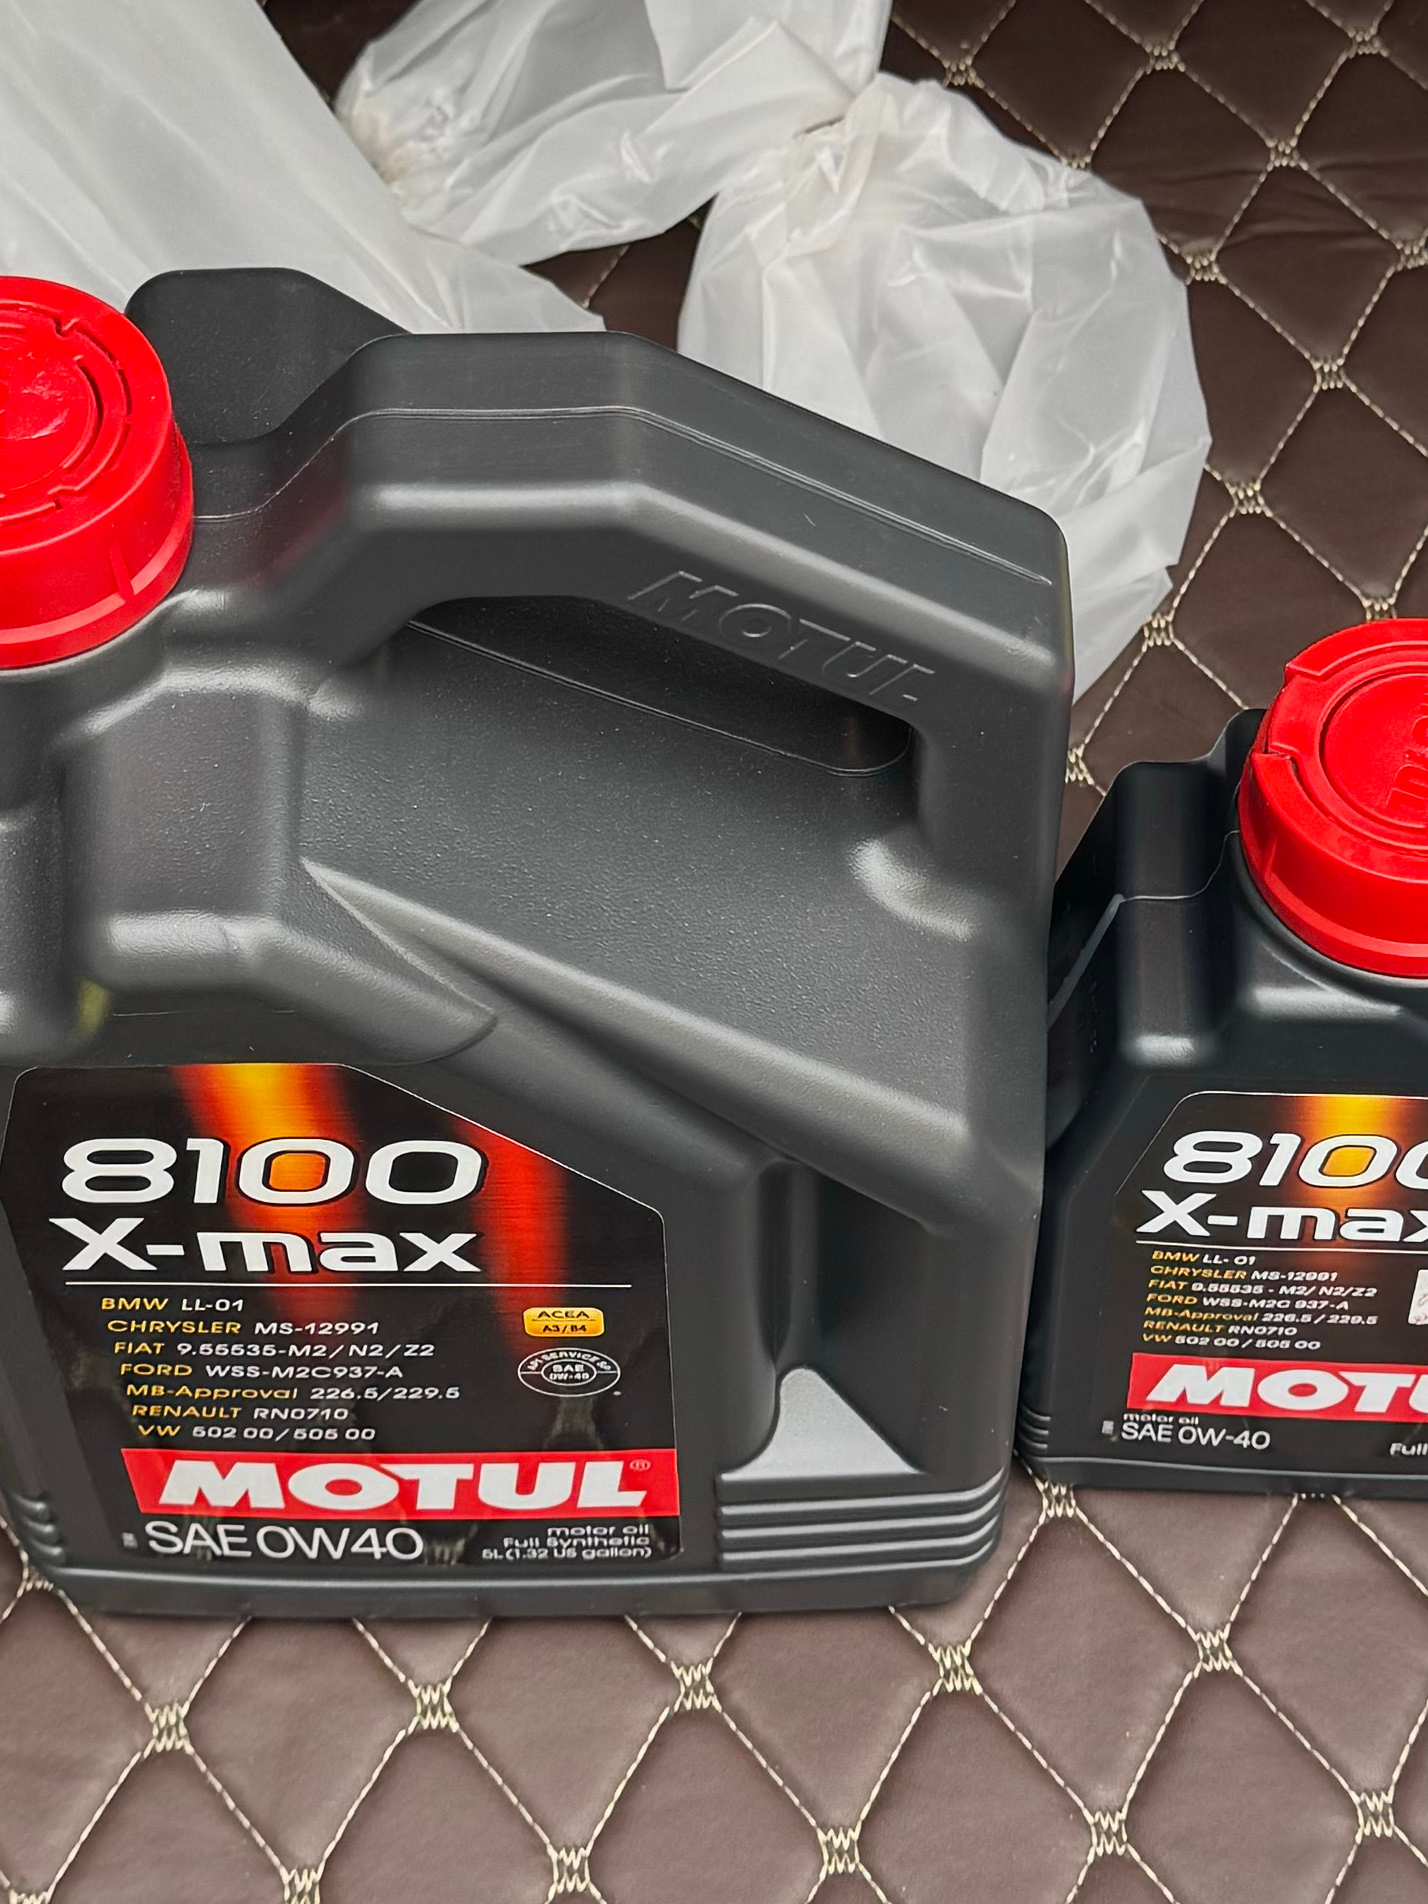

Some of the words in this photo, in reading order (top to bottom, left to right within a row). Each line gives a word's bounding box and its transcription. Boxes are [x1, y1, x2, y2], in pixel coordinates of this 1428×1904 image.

[628, 570, 936, 702] MOTUL
[62, 1137, 482, 1204] 8100
[49, 1217, 481, 1272] X-max
[1151, 1250, 1200, 1263] BMW
[1150, 1265, 1248, 1280] CHRYSLER
[1147, 1279, 1188, 1290] FIAT
[101, 1297, 169, 1311] BMW
[182, 1299, 244, 1312] LL-01
[1146, 1293, 1198, 1305] FORD
[537, 1311, 590, 1319] ACEA
[1144, 1307, 1259, 1322] MB-Approval
[107, 1320, 242, 1334] CHRYSLER
[254, 1322, 379, 1336] MS-12991
[1143, 1321, 1225, 1333] RENAULT
[1228, 1324, 1297, 1336] RN0710
[1142, 1333, 1172, 1343] VW
[114, 1342, 165, 1355] FIAT
[120, 1363, 193, 1377] FORD
[205, 1364, 404, 1379] WSS-M2C937-A
[552, 1364, 584, 1373] SAE
[126, 1383, 299, 1401] MB-Approval
[309, 1386, 460, 1401] 226.5/229.5
[132, 1405, 242, 1419] RENAULT
[253, 1407, 349, 1421] RN0710
[1123, 1413, 1174, 1424] motor
[1178, 1415, 1199, 1425] oil
[138, 1424, 181, 1437] VW
[191, 1426, 237, 1439] 502
[344, 1428, 376, 1441] 00
[1121, 1421, 1173, 1443] SAE
[1178, 1425, 1271, 1450] 0W-40
[1389, 1443, 1428, 1456] Full
[158, 1459, 648, 1510] MOTUL
[547, 1525, 616, 1536] motor
[622, 1523, 649, 1535] oil
[145, 1520, 252, 1556] SAE
[257, 1524, 423, 1561] 0W40
[503, 1537, 540, 1549] Full
[546, 1536, 650, 1550] Synthetic
[553, 1548, 577, 1560] US
[582, 1546, 652, 1560] gallon)
